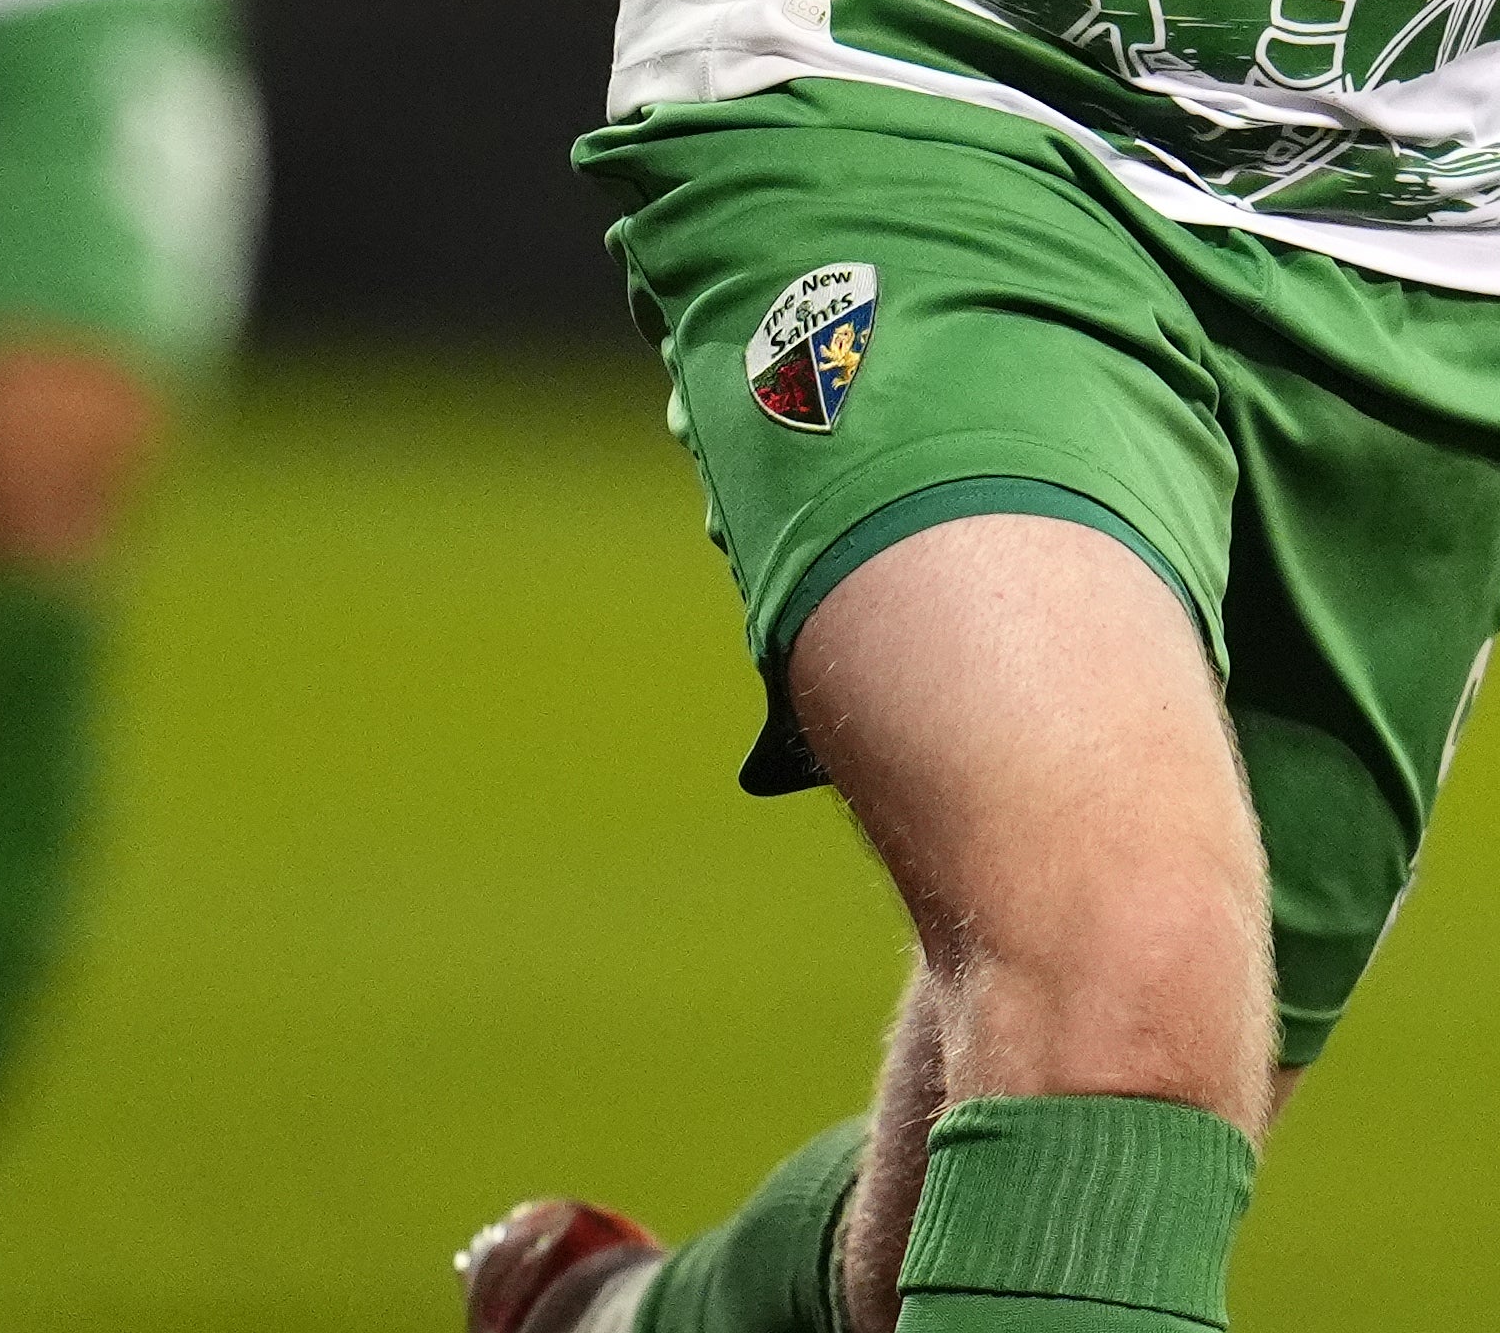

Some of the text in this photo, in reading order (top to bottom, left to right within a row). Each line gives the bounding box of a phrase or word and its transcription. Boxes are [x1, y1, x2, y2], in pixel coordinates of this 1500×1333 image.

[764, 269, 853, 338] The New
[769, 292, 854, 360] Saints
